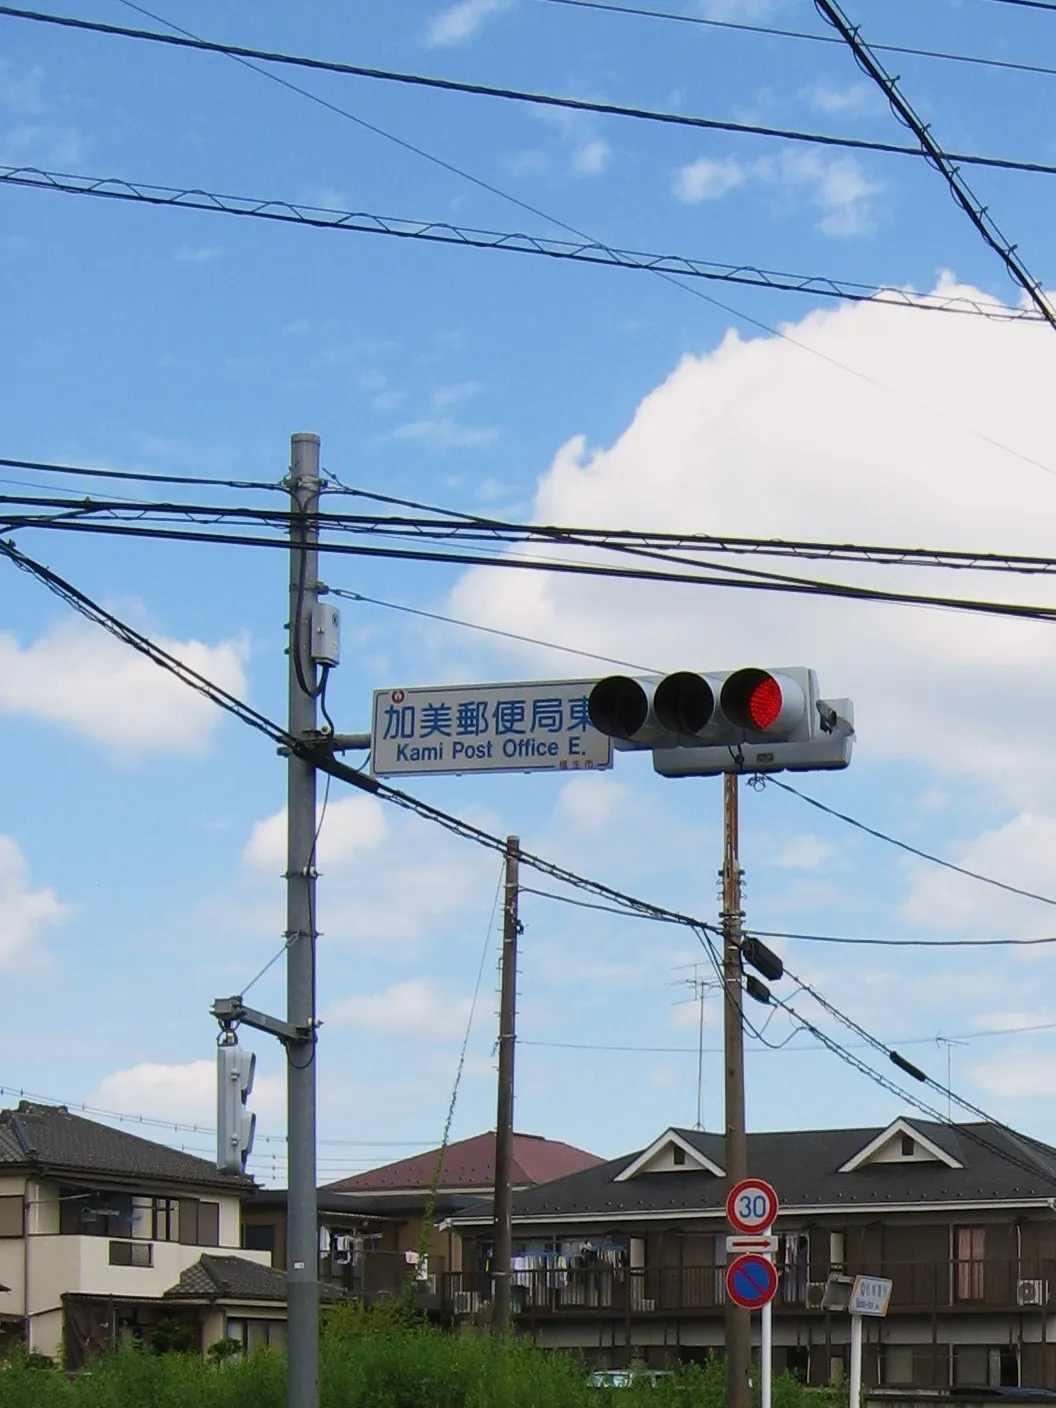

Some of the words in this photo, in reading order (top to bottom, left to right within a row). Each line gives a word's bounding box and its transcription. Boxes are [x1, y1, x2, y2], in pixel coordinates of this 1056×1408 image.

[396, 742, 443, 761] Kami
[452, 740, 492, 760] Post
[503, 738, 558, 757] Office
[568, 736, 586, 756] E.
[738, 1196, 766, 1218] 30
